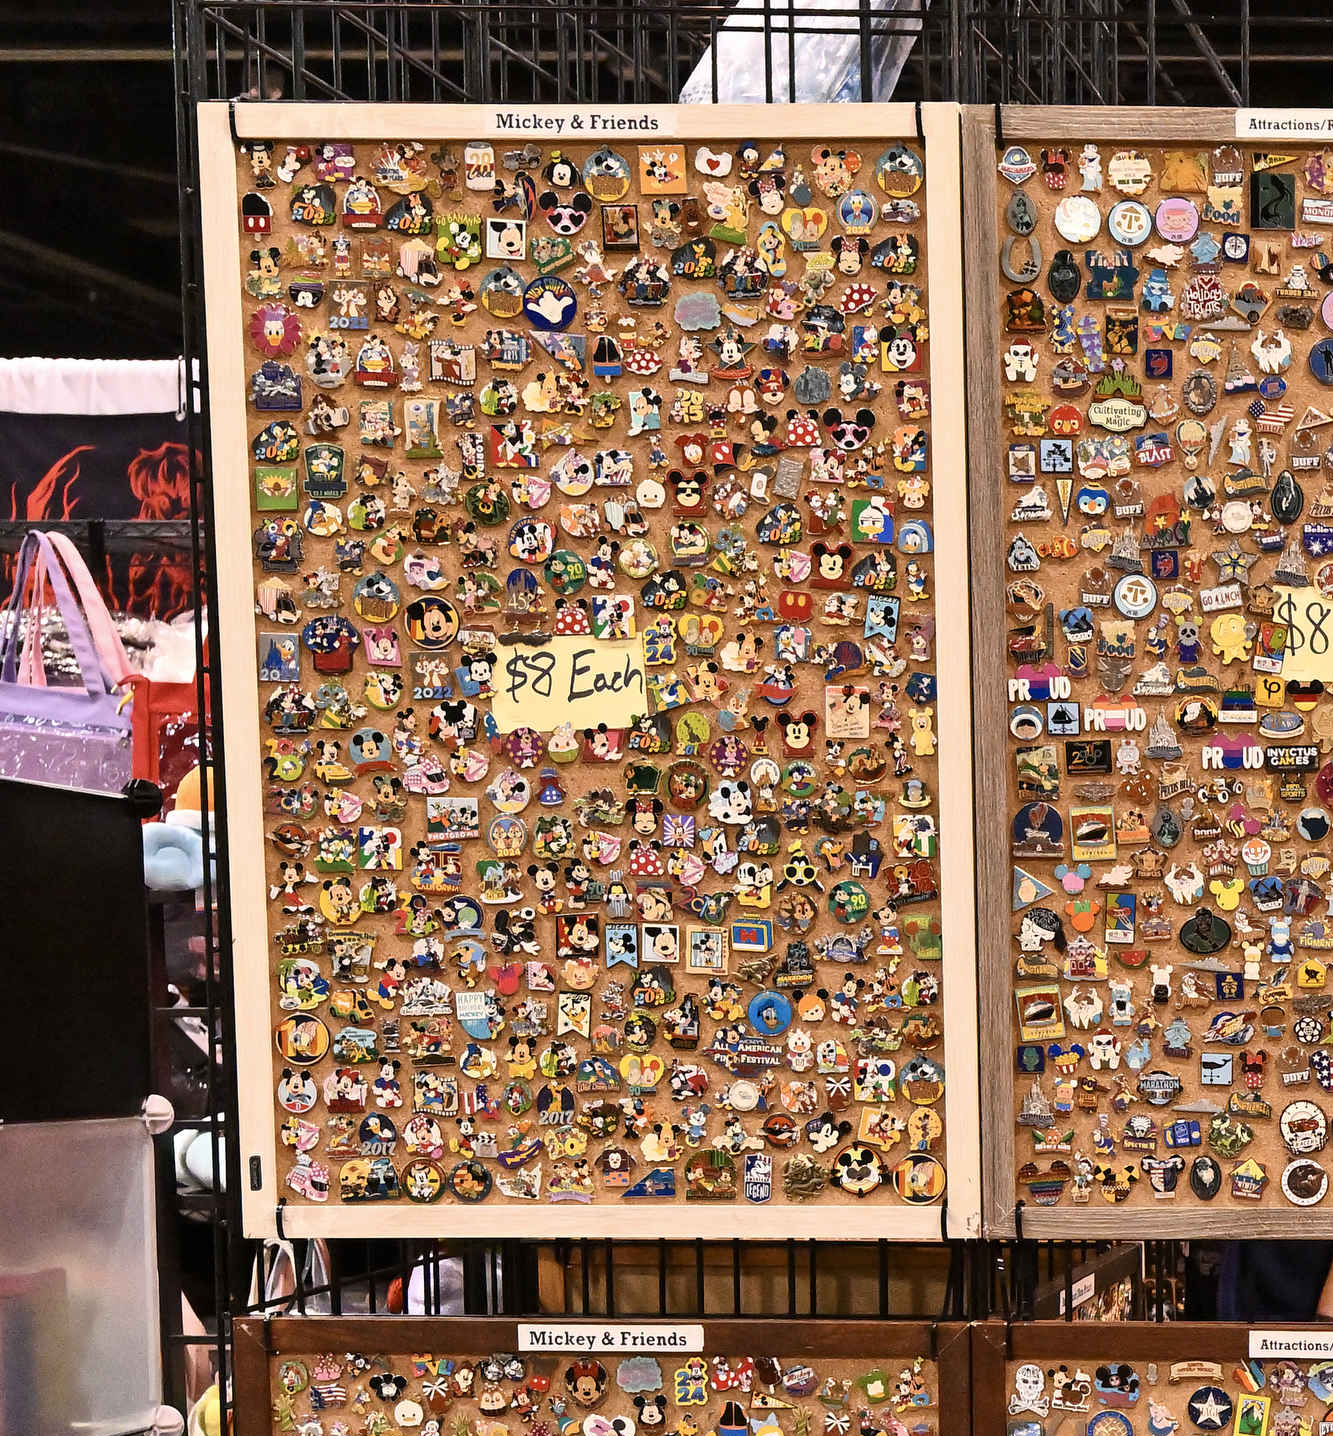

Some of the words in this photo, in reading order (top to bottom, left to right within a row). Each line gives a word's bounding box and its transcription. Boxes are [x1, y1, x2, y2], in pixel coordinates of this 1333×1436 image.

[496, 114, 564, 133] Mickey
[571, 115, 583, 129] &
[591, 115, 658, 129] Friends
[1187, 288, 1220, 301] HOLIDAY
[1190, 301, 1221, 313] TREATS
[1093, 404, 1142, 417] Cultivating
[1106, 418, 1131, 427] Magic
[475, 433, 485, 478] FLORIDA
[1139, 449, 1172, 463] BLAST
[1278, 593, 1330, 657] $8
[506, 648, 556, 704] $8
[568, 649, 643, 703] Each
[1267, 747, 1317, 757] INVICTUS
[1270, 756, 1310, 765] GAMES
[738, 1043, 782, 1054] AMERICAN
[740, 1055, 781, 1066] FESTIVAL
[540, 1111, 574, 1125] 2017
[361, 1142, 396, 1156] 2017
[748, 1182, 769, 1198] LEGEND
[530, 1332, 595, 1349] Mickey
[602, 1332, 614, 1345] &
[621, 1332, 687, 1346] Friends
